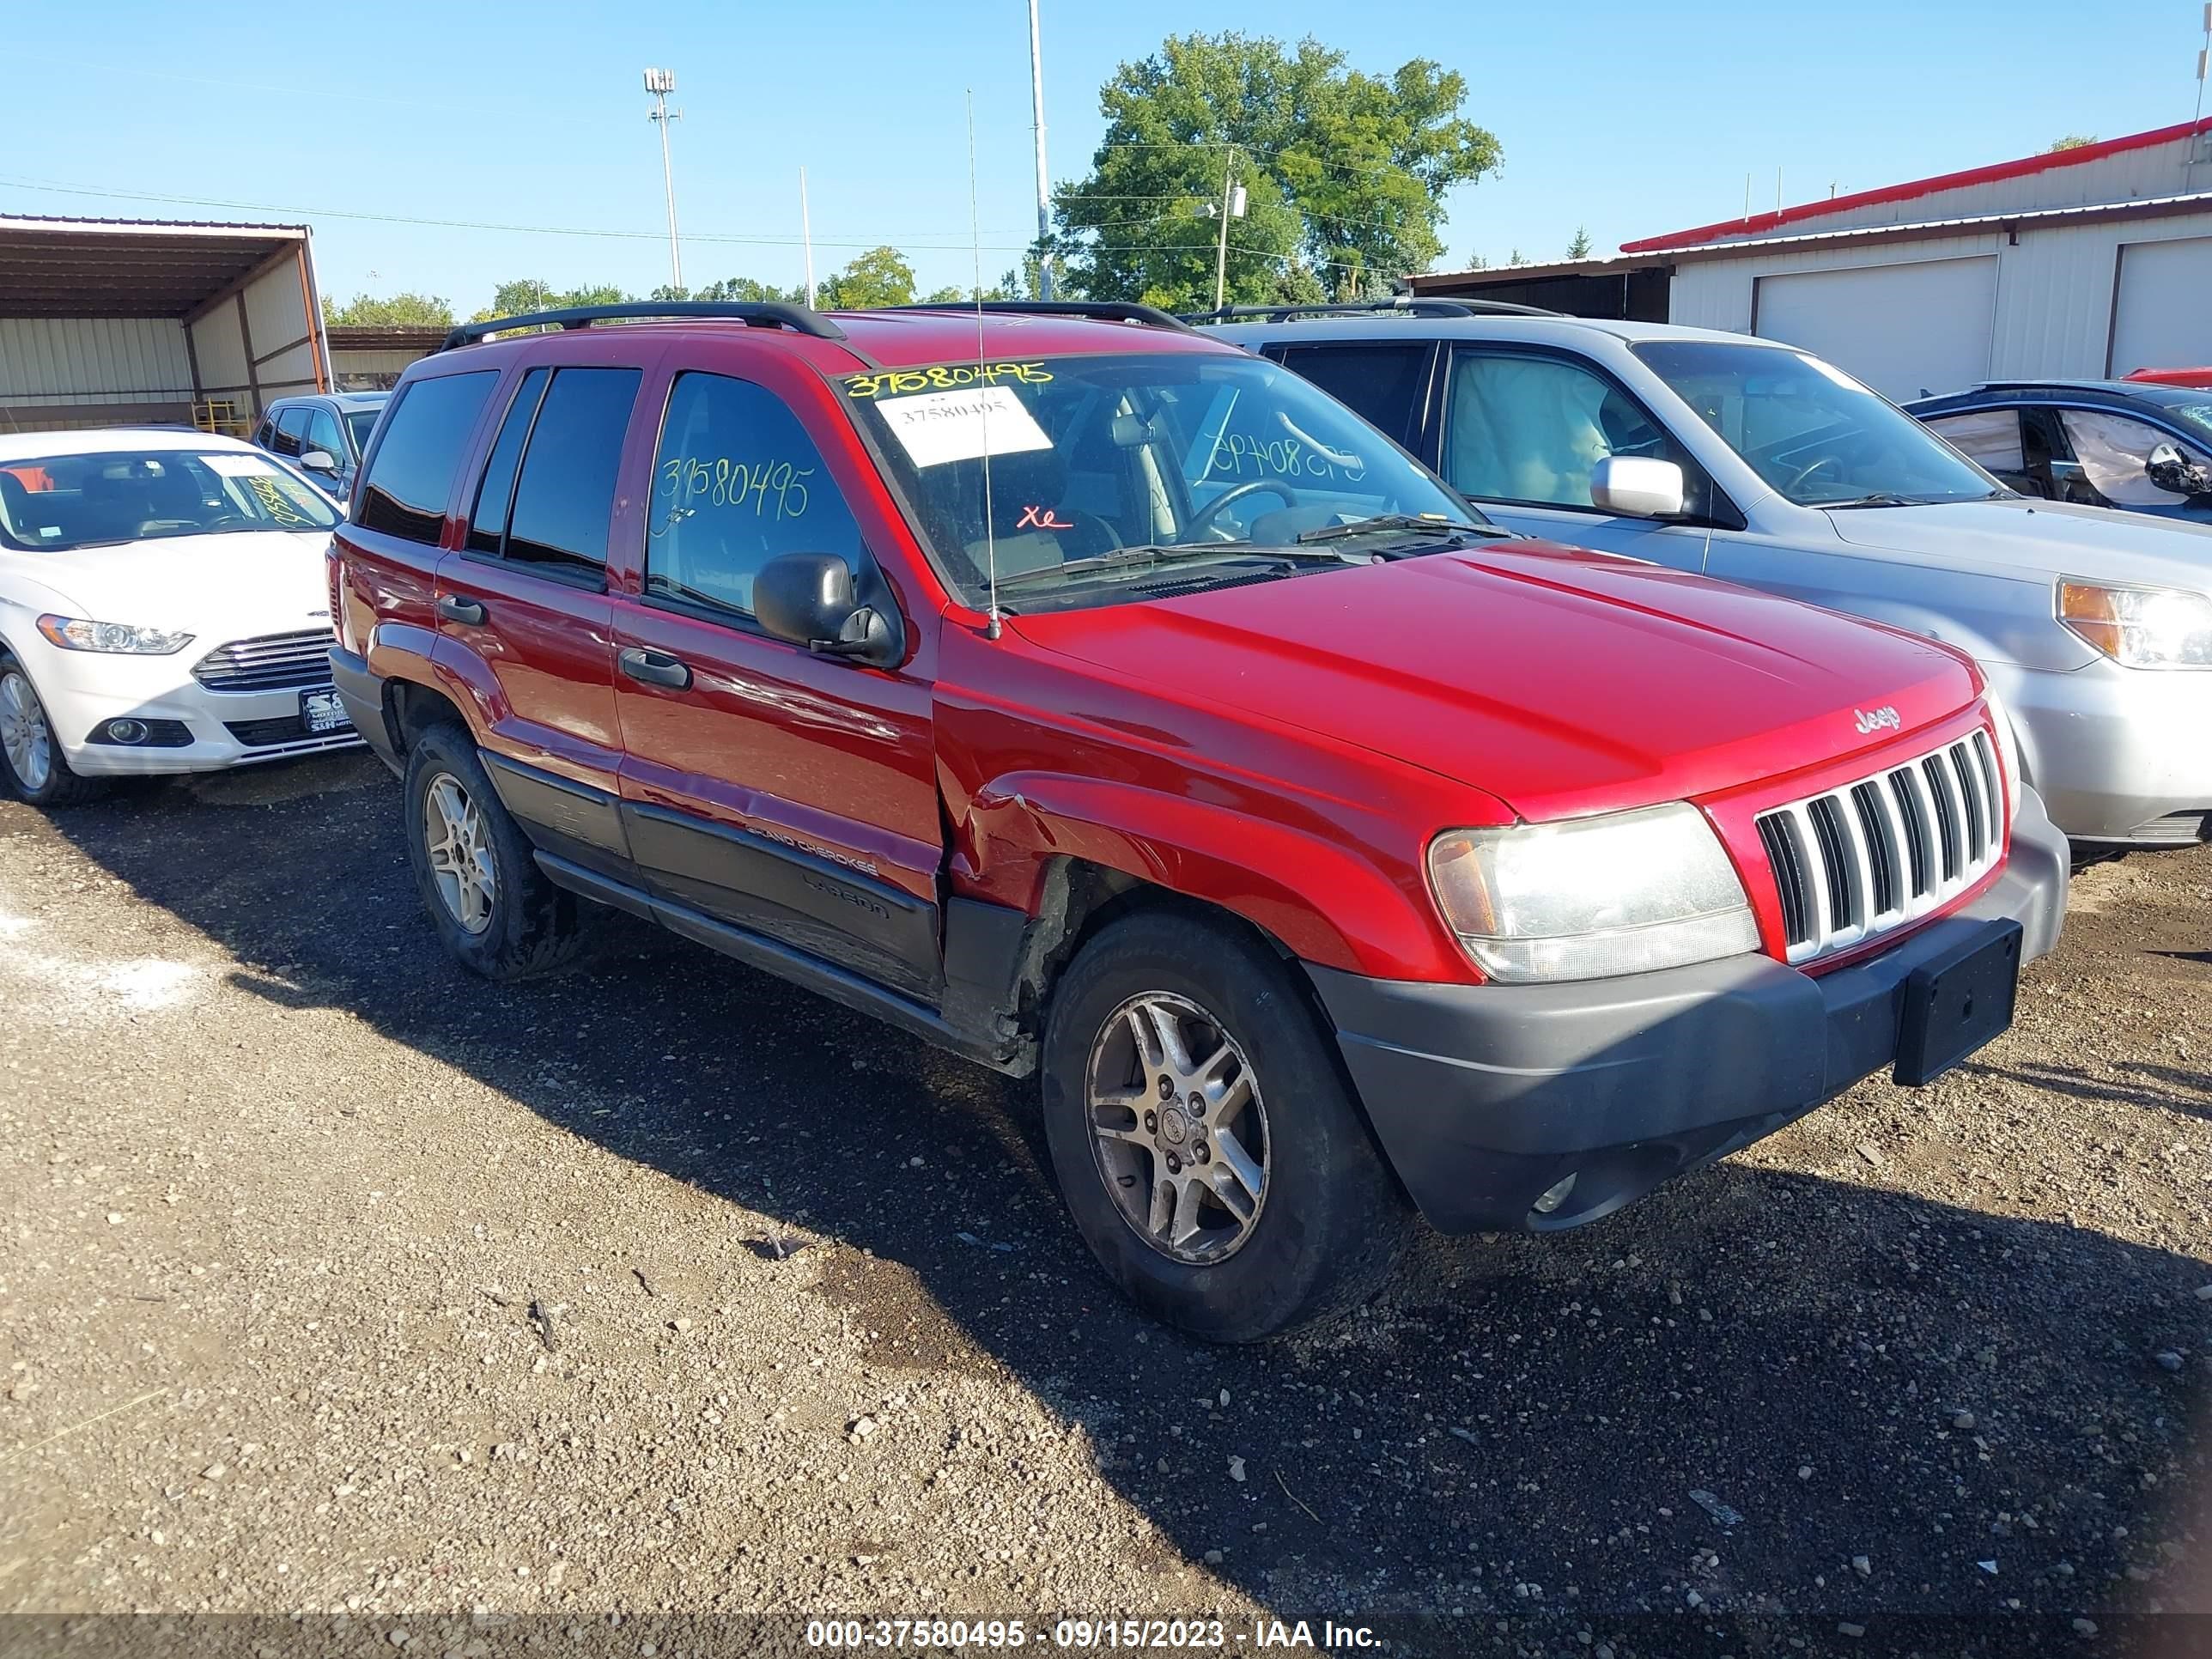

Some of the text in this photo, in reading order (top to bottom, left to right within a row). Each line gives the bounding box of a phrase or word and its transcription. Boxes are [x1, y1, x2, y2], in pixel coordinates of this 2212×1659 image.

[844, 362, 1054, 398] 37580495
[660, 458, 815, 521] 37580495
[1854, 706, 1901, 734] Jeep
[799, 842, 879, 877] CHEROKEE
